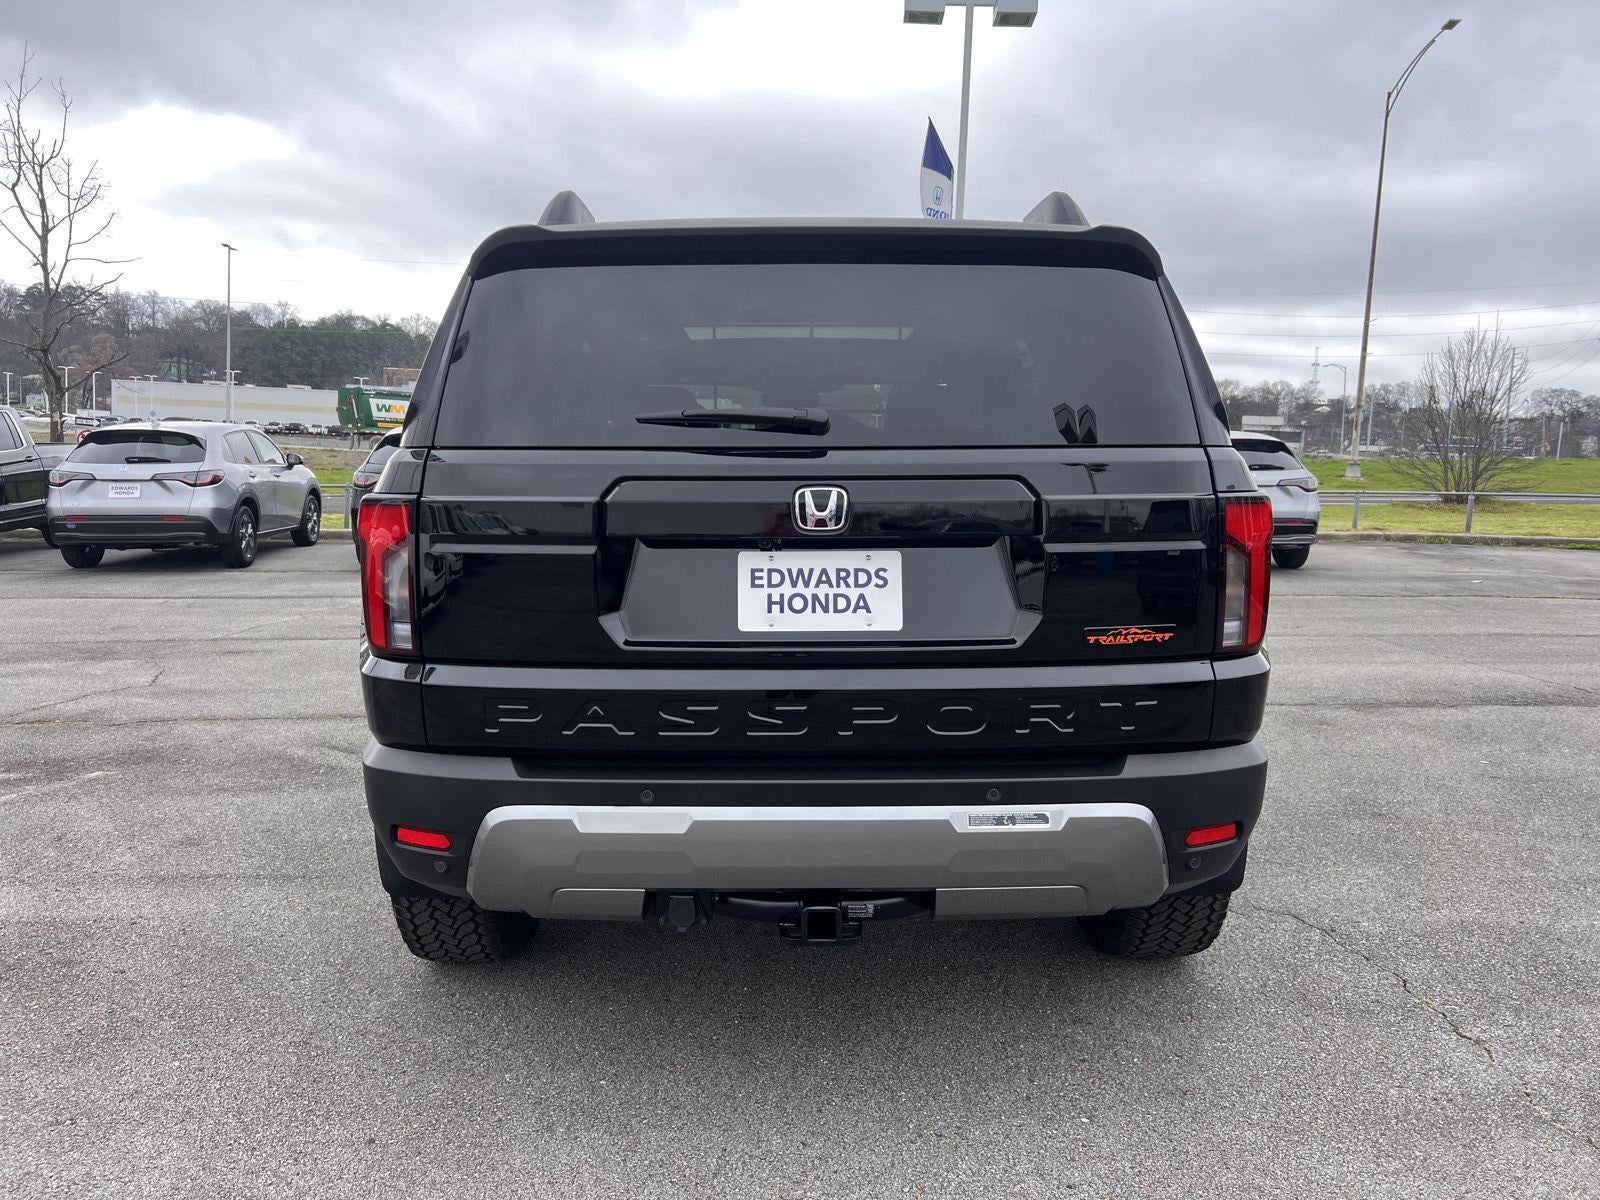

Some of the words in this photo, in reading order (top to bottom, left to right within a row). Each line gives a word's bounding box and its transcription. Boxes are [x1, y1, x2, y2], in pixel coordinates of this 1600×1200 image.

[376, 403, 406, 413] WM
[750, 567, 889, 589] EDWARDS
[766, 592, 872, 614] HONDA
[1087, 633, 1174, 645] TRAILSPORT
[483, 698, 1159, 736] PASSPORT
